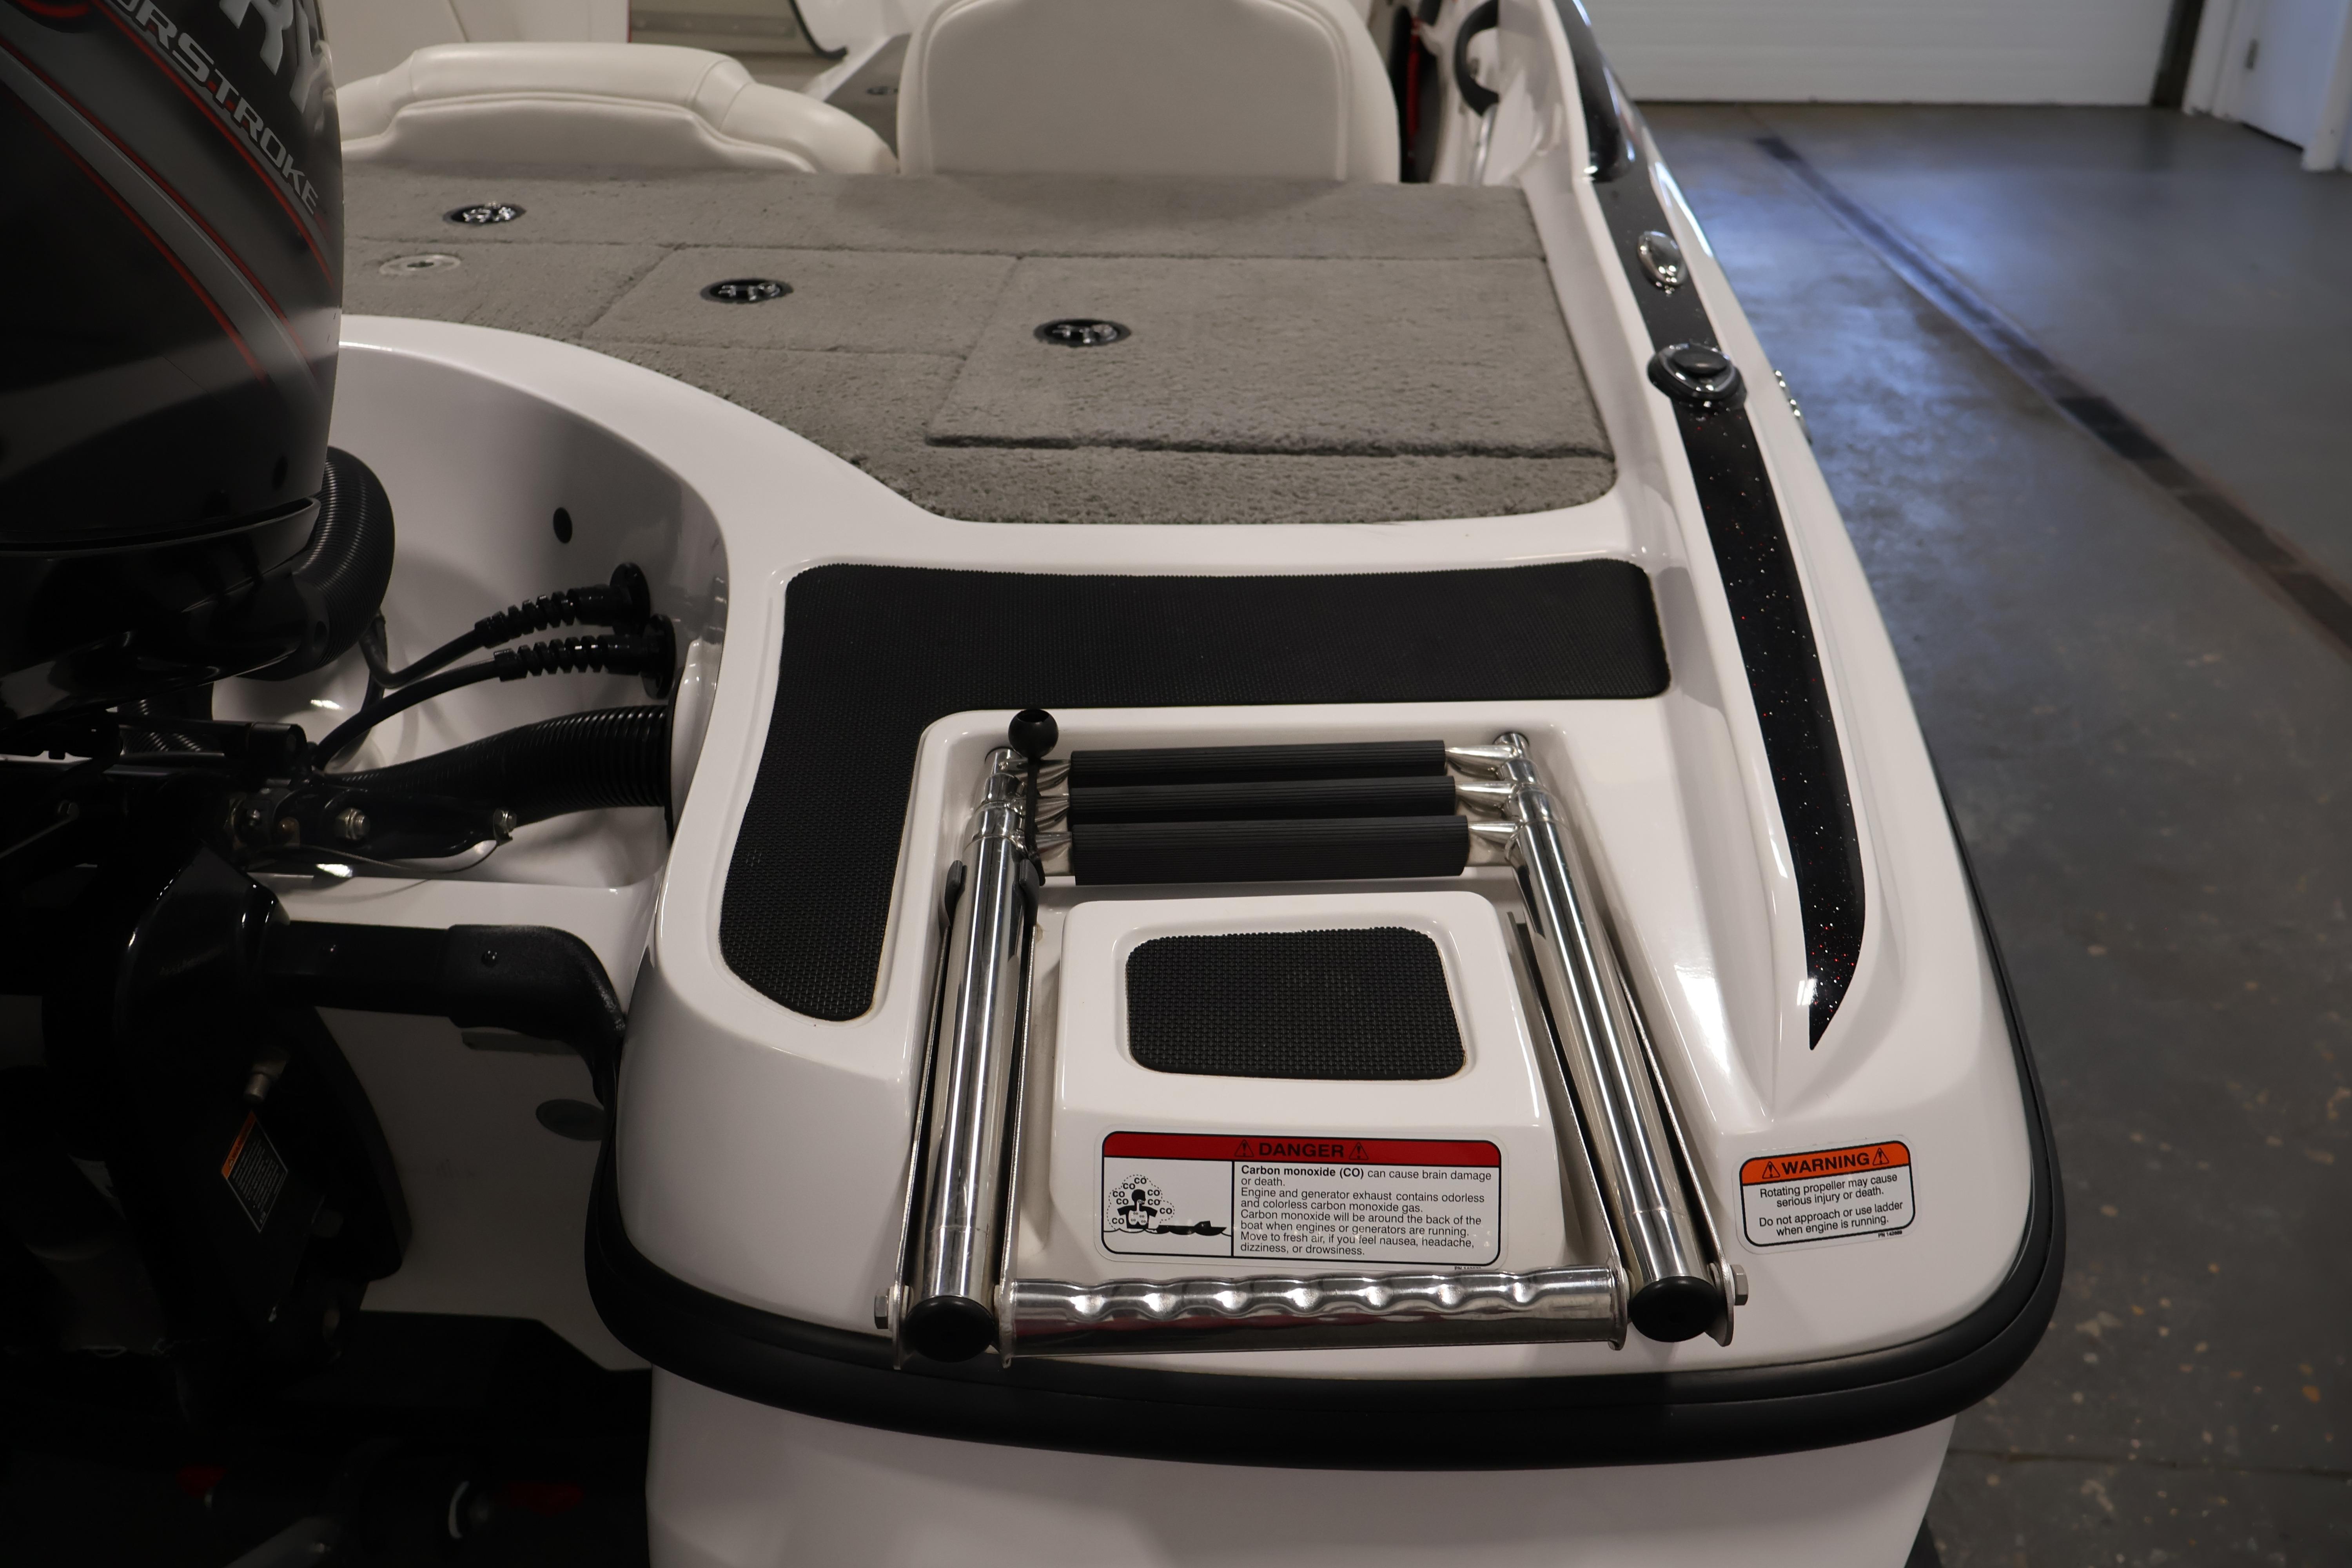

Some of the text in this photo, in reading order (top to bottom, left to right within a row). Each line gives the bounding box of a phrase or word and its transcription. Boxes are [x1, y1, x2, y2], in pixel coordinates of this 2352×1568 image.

[1259, 1143, 1344, 1158] DANGER
[1781, 1152, 1869, 1175] WARNING
[1241, 1165, 1280, 1175] Carbon
[1283, 1167, 1336, 1177] monoxide
[1339, 1167, 1364, 1180] (CO)
[1389, 1171, 1419, 1179] cause
[1422, 1170, 1447, 1180] brain
[1450, 1171, 1492, 1183] damage
[1254, 1176, 1285, 1187] death.
[1241, 1187, 1485, 1203] Engine and generator exhaust contains odorless
[1760, 1174, 1898, 1198] Rotating propeller may cause
[1241, 1198, 1423, 1214] and colorless carbon monoxide gas.
[1776, 1186, 1884, 1208] serious injury or death.
[1241, 1209, 1482, 1225] Carbon monoxide will be around the back of the
[1759, 1201, 1903, 1227] Do not approach or use ladder
[1241, 1220, 1263, 1230] boat
[1265, 1221, 1293, 1231] when
[1296, 1222, 1336, 1234] engines
[1352, 1225, 1406, 1235] generators
[1428, 1226, 1469, 1238] running.
[1776, 1215, 1889, 1236] when engine is running.
[1240, 1242, 1289, 1254] dizziness,
[1305, 1244, 1365, 1255] drowsiness.
[1241, 1231, 1474, 1249] Move to fresh air, if you feel nausea, headache,
